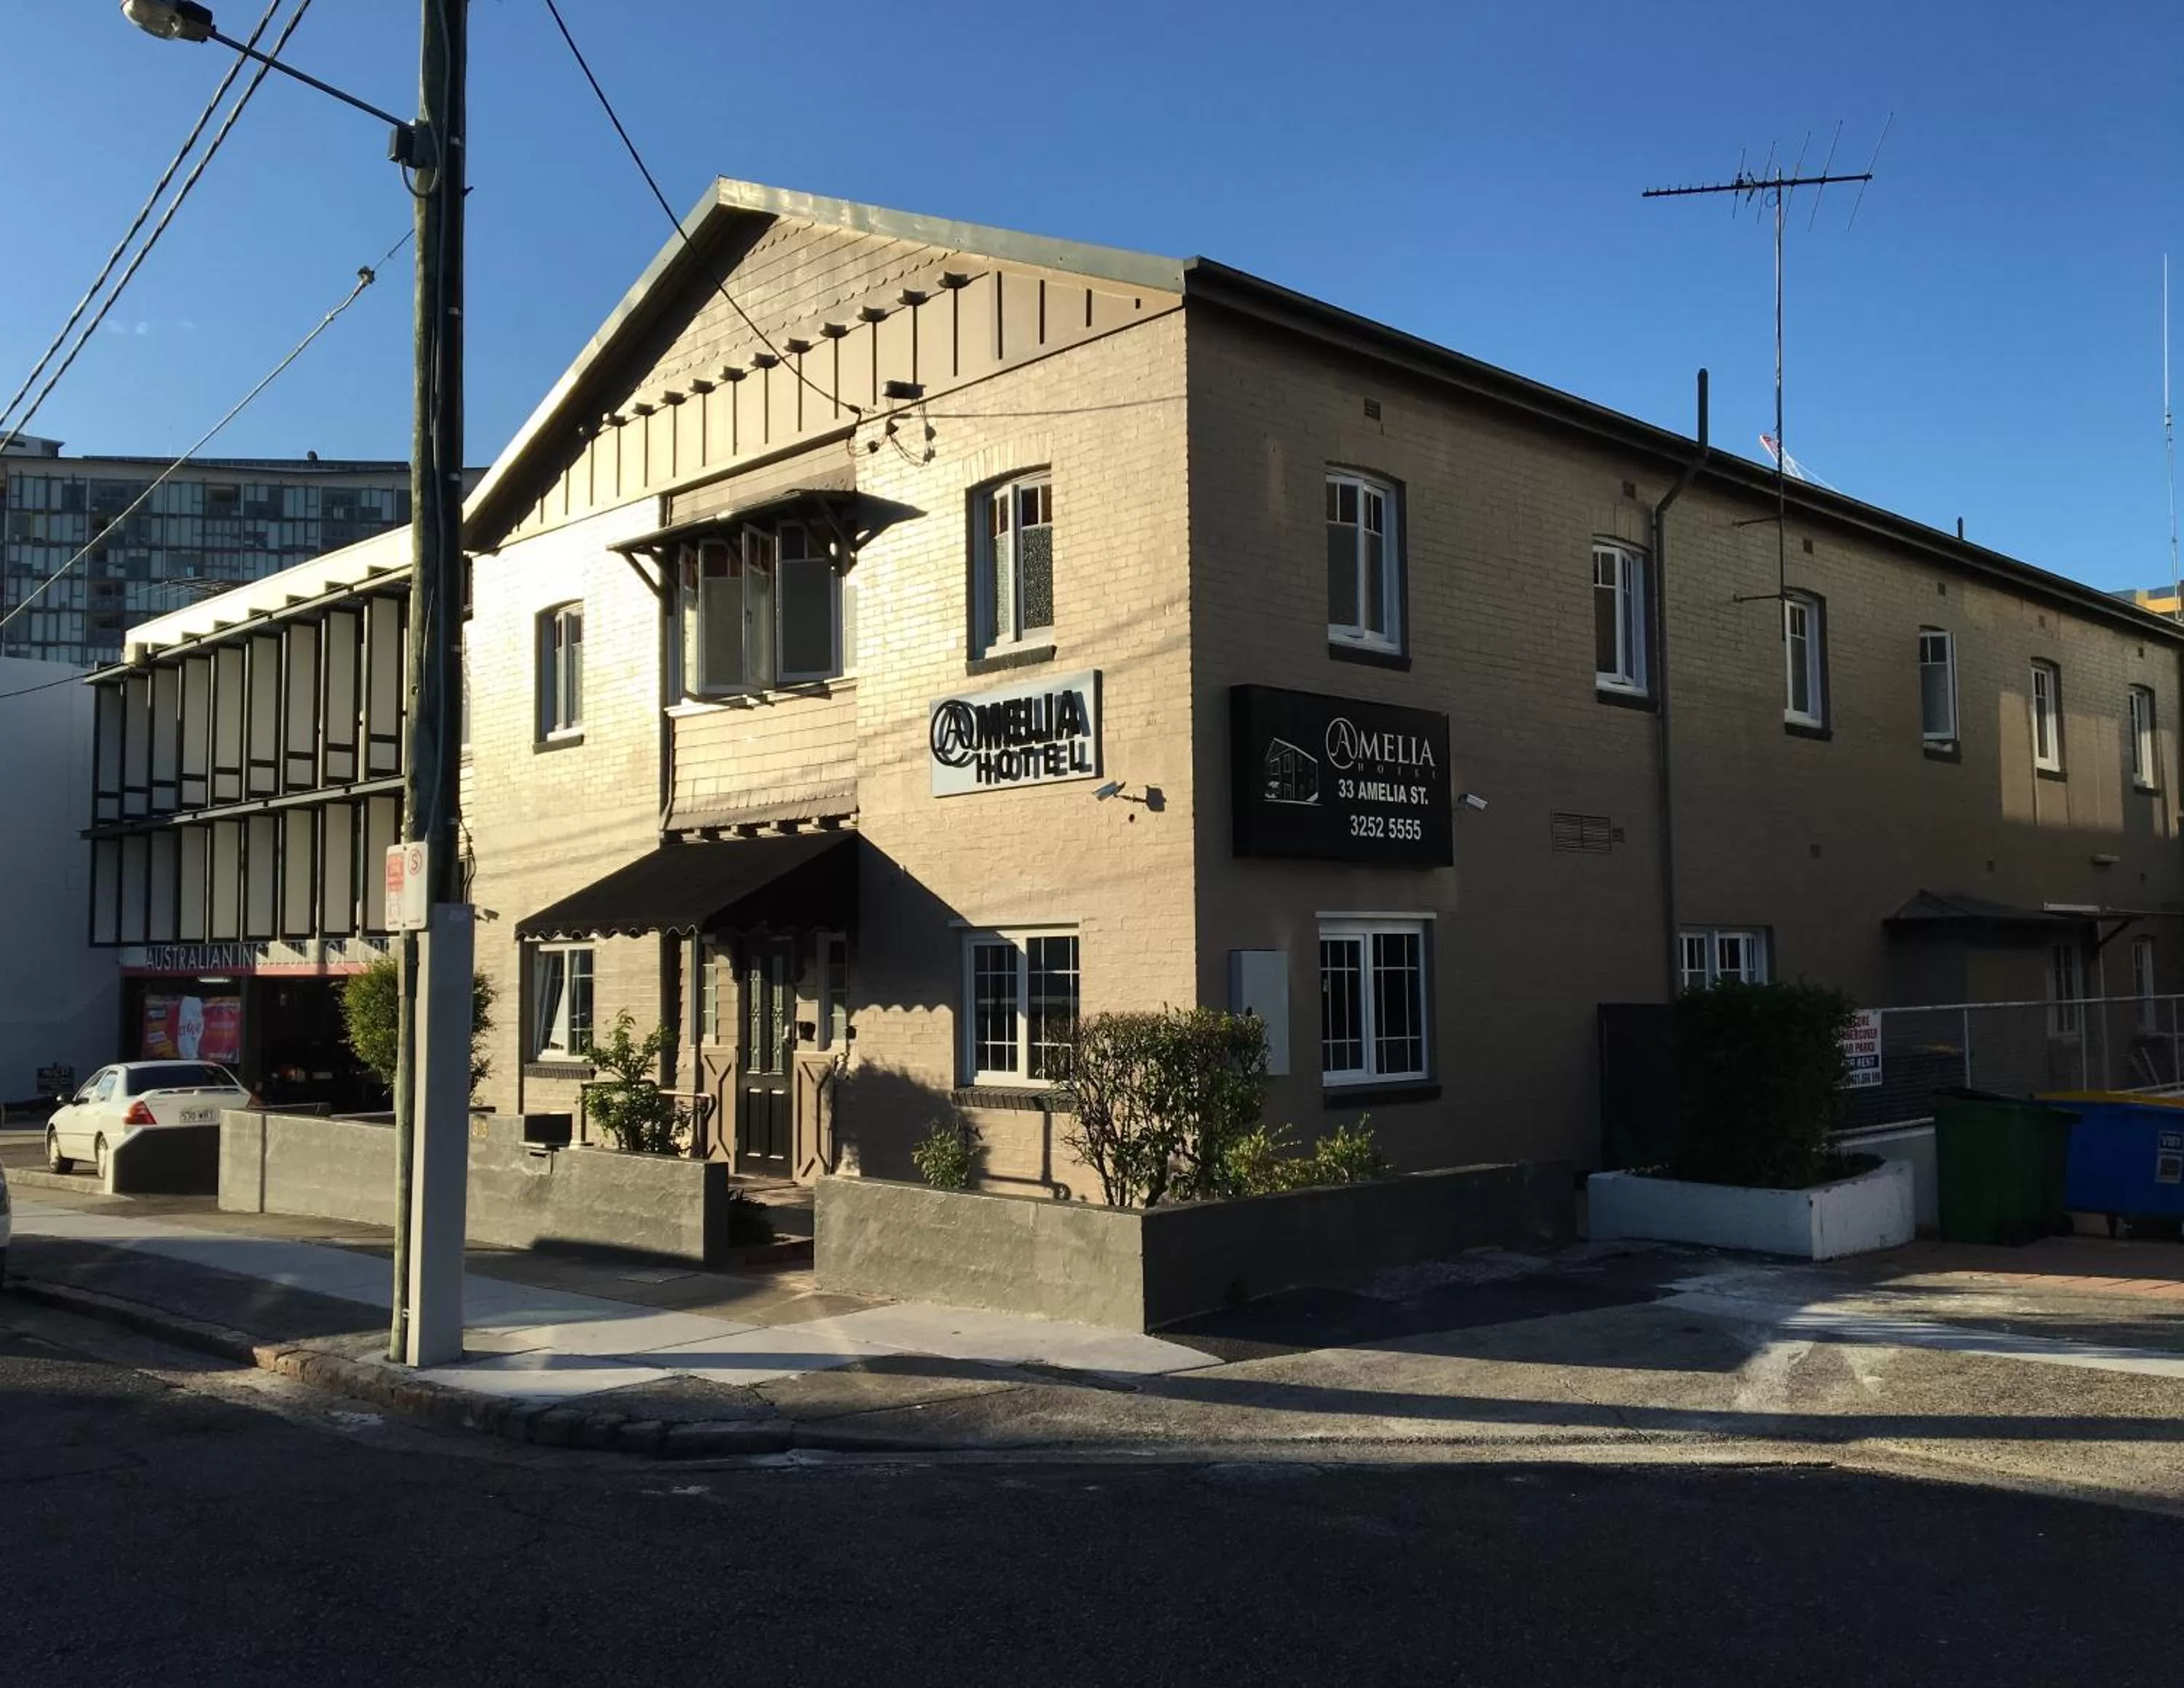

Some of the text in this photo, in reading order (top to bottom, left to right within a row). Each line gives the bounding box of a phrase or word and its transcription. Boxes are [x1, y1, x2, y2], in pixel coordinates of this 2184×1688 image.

[930, 690, 1081, 766] AMELIA
[1326, 717, 1436, 769] AMELIA
[976, 740, 1082, 784] HOTEL
[1358, 763, 1438, 780] HOTEL
[1338, 778, 1429, 805] 33 AMELIA ST.
[1350, 815, 1422, 840] 3252 5555
[146, 944, 232, 971] AUSTRALIAN
